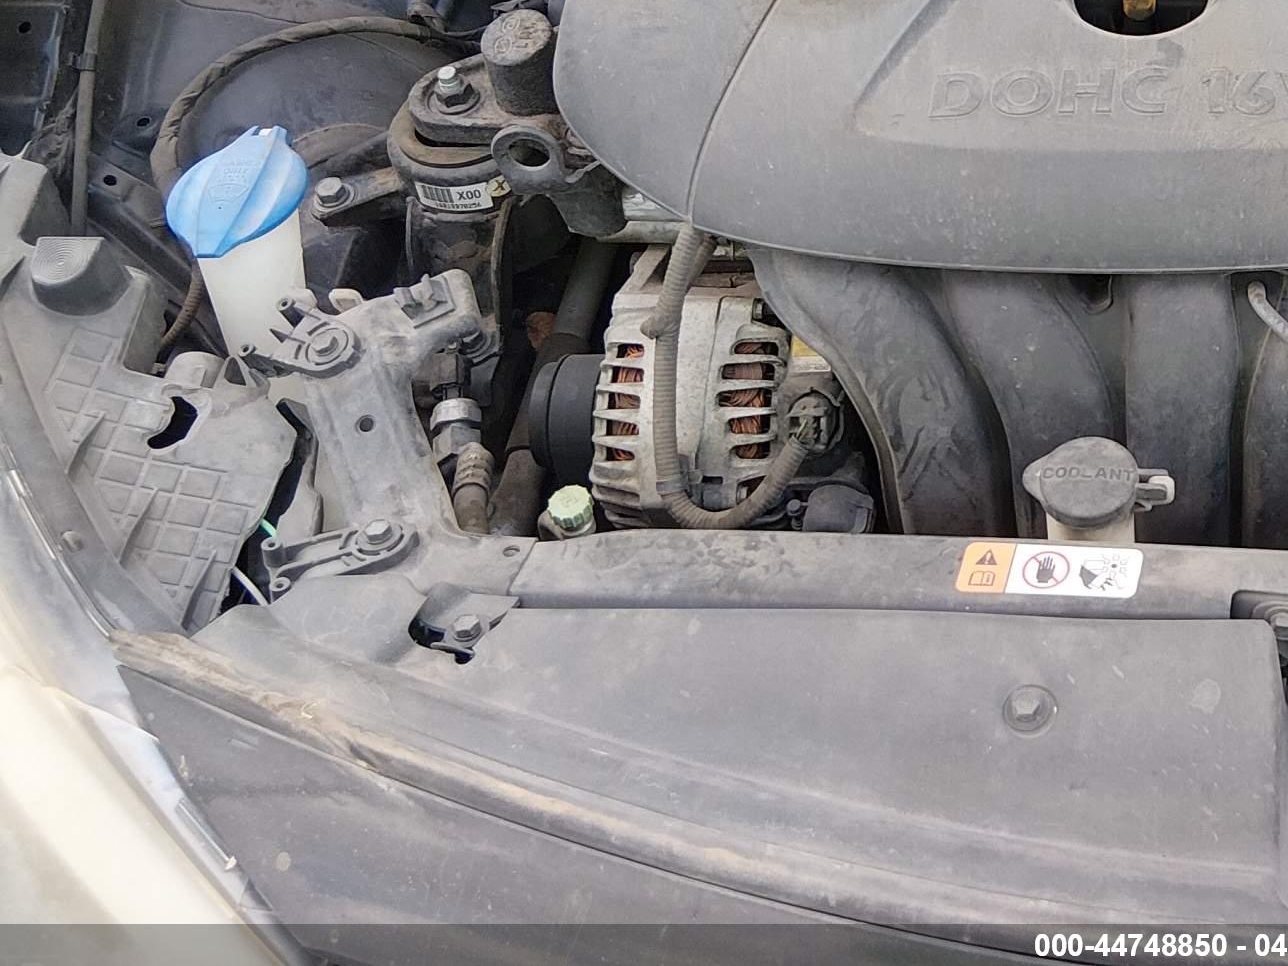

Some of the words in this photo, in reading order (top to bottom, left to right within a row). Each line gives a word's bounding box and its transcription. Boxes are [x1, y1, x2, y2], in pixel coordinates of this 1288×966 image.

[927, 65, 1170, 119] DOHC
[456, 189, 481, 200] X00
[1043, 466, 1136, 481] COOLANT
